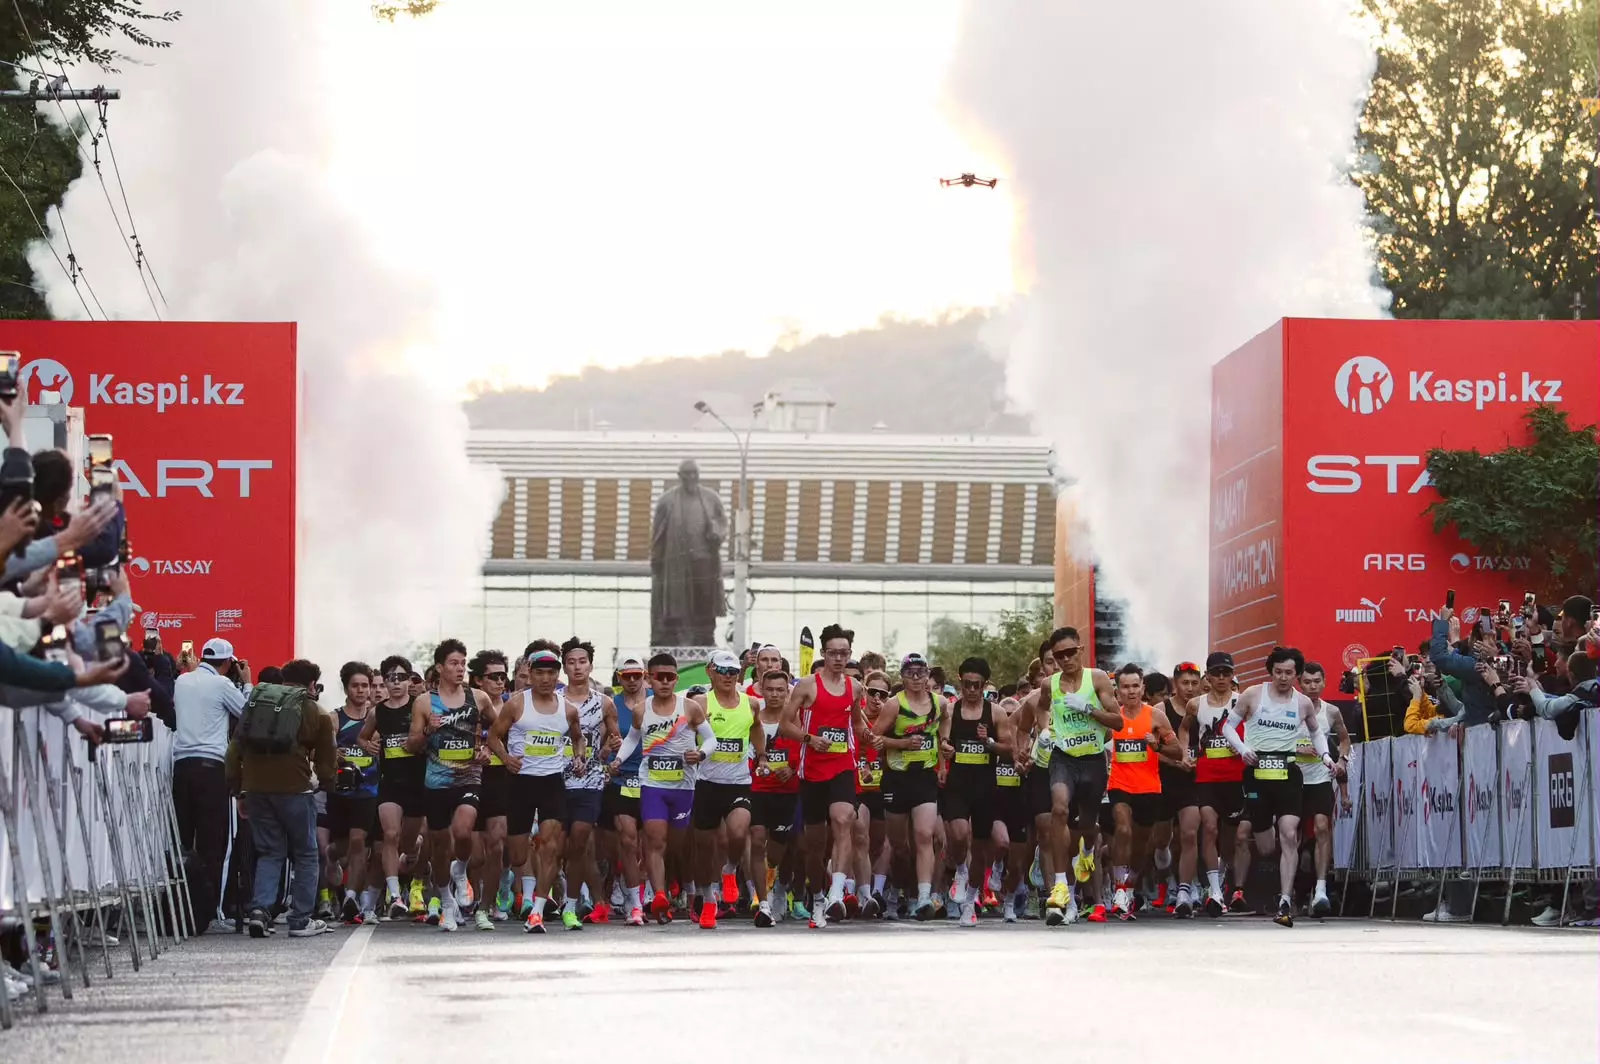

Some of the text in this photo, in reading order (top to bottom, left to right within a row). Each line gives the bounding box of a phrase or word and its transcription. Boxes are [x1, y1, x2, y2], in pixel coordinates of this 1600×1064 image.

[90, 374, 244, 413] Kaspi.kz
[1409, 371, 1562, 410] Kaspi.kz
[112, 459, 272, 498] ART
[153, 560, 213, 574] TASSAY
[1223, 537, 1276, 598] MARATHON
[1364, 553, 1425, 571] ARG
[1336, 609, 1375, 623] PUMA
[157, 619, 182, 628] AIMS
[1257, 719, 1296, 731] QAZAQSTAN
[444, 740, 469, 749] 7534
[532, 735, 555, 745] 7441
[1064, 732, 1097, 748] 10945
[1209, 738, 1230, 748] 783
[715, 743, 740, 752] 8538
[961, 743, 984, 754] 7189
[1119, 743, 1141, 752] 7041
[767, 753, 786, 762] 361
[653, 761, 678, 770] 9027
[1259, 760, 1285, 769] 8835
[1551, 772, 1572, 808] ARG
